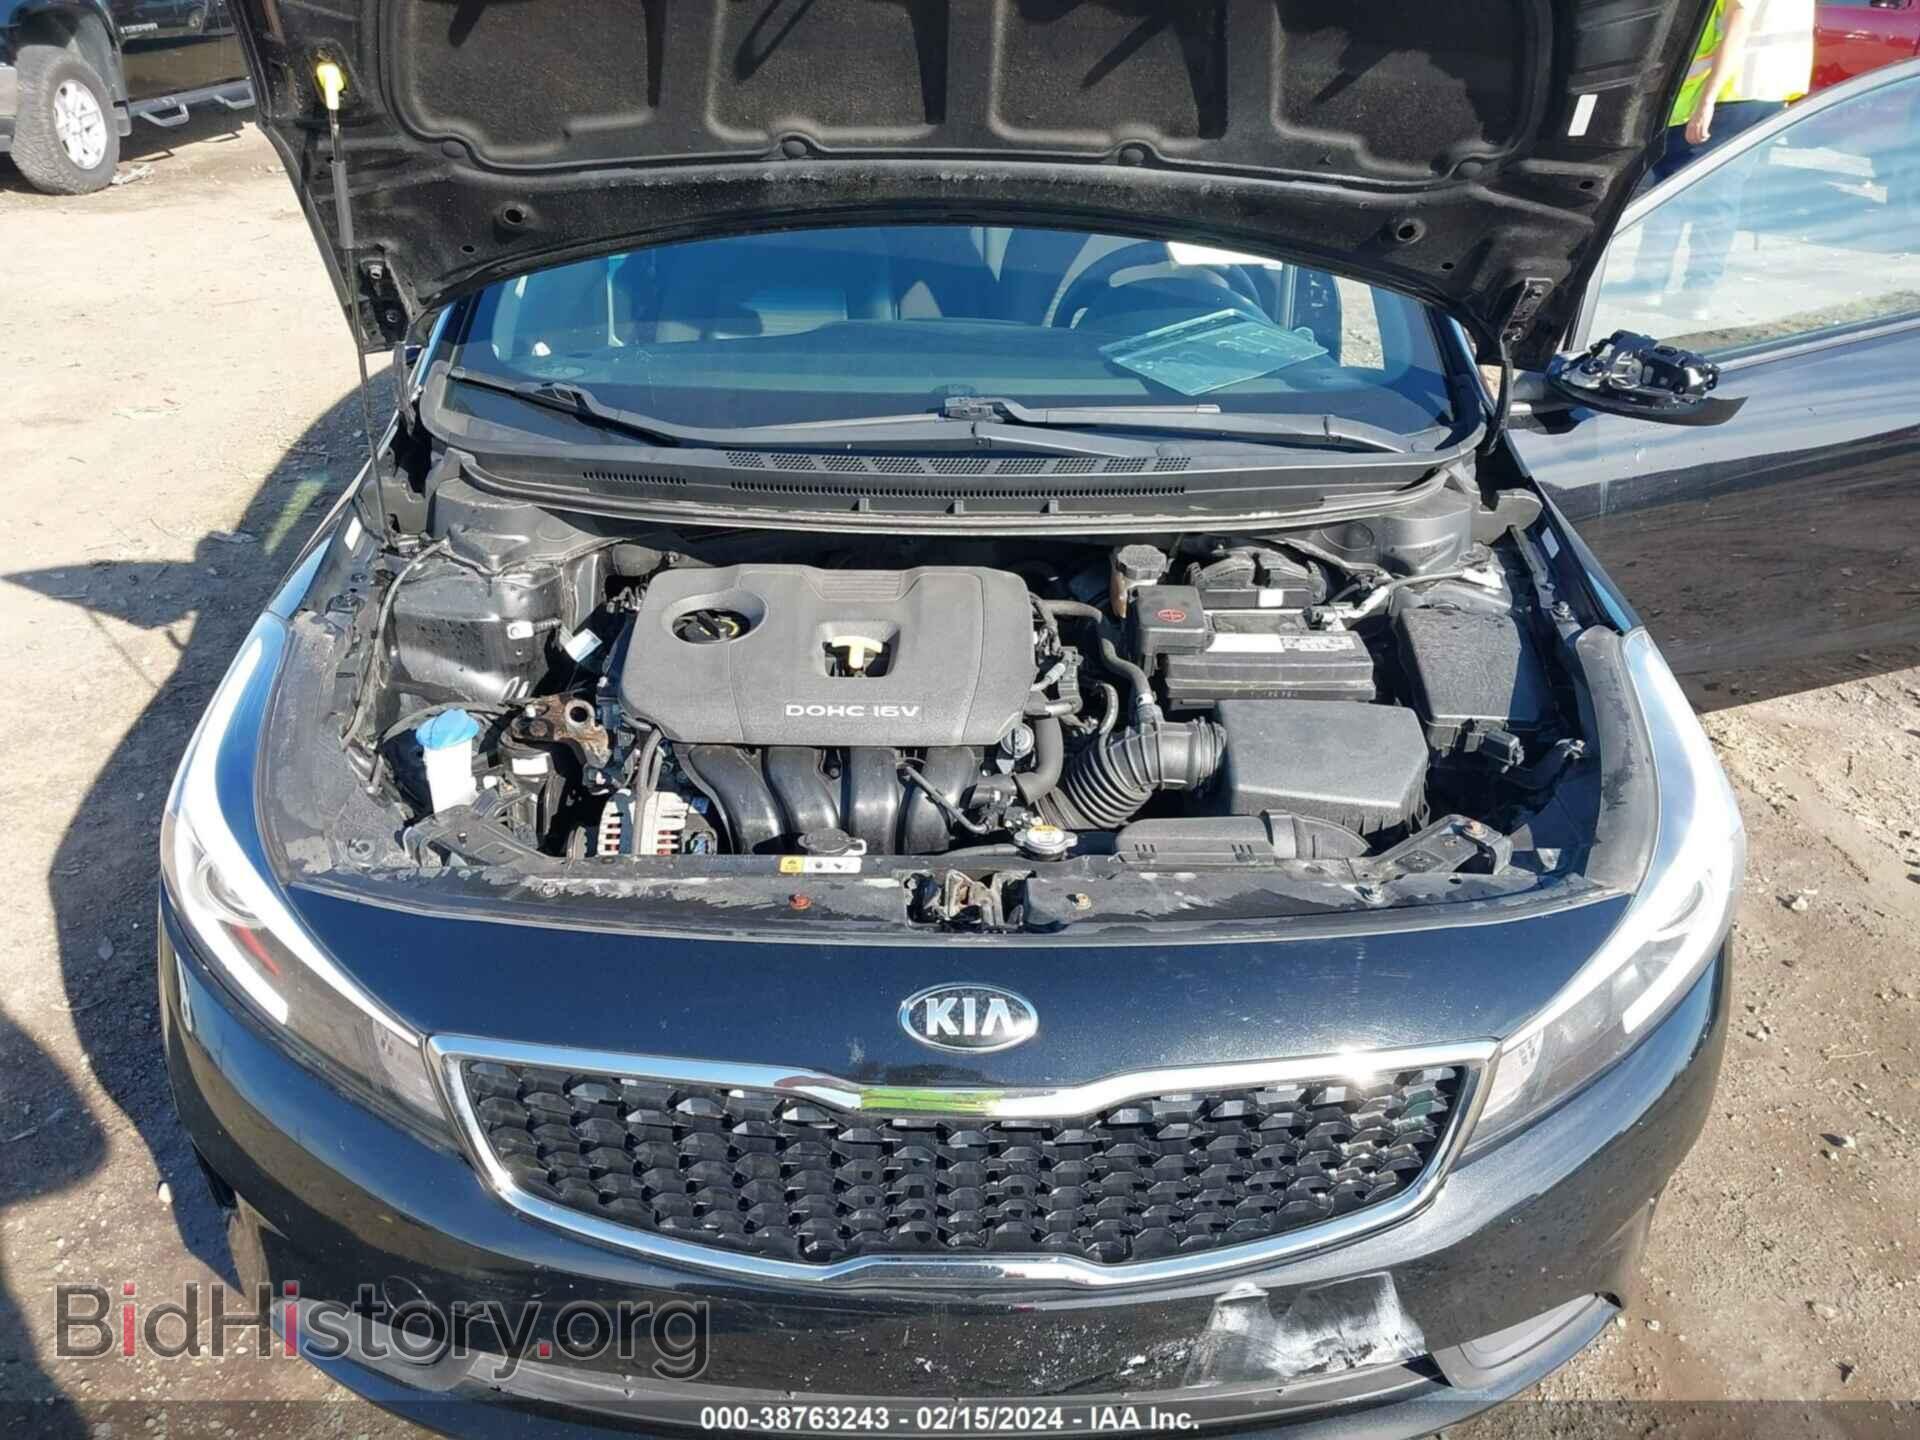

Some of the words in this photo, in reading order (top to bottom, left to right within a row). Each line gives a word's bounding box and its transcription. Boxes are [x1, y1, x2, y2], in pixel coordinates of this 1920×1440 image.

[785, 704, 865, 718] DOHC
[872, 704, 920, 718] 16V
[924, 997, 1018, 1036] KIA
